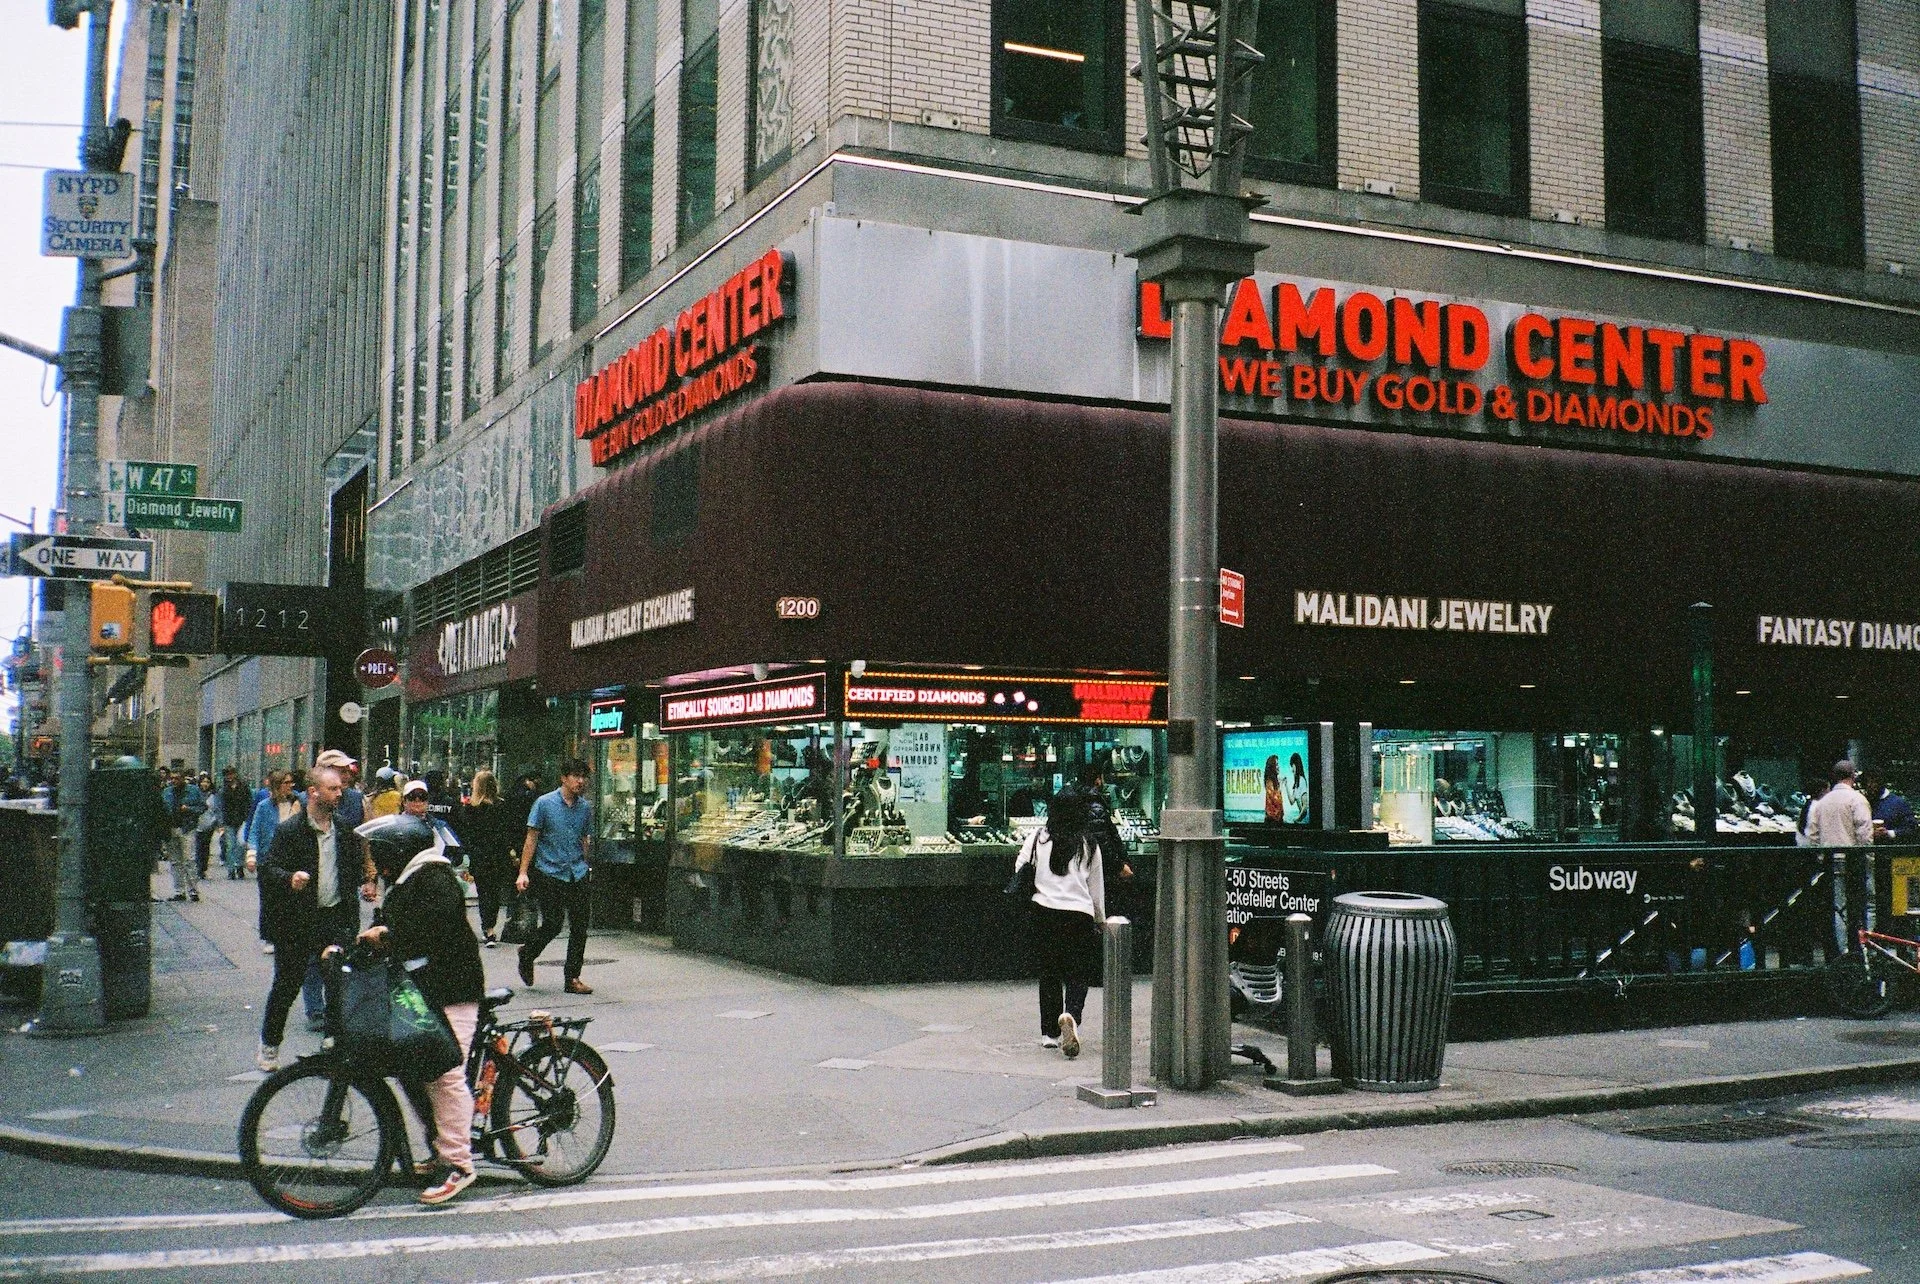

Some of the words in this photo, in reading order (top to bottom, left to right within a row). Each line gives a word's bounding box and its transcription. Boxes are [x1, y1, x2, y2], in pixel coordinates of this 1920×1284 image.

[57, 177, 118, 195] NYPD
[49, 234, 123, 251] CAMERA
[576, 327, 671, 439] DIAMOND
[675, 248, 784, 377] CENTER
[1141, 278, 1490, 371] AMOND
[1514, 313, 1769, 404] CENTER
[1219, 355, 1282, 397] WE
[1293, 364, 1369, 405] BUY
[1376, 372, 1483, 415] GOLD
[1492, 385, 1517, 419] &
[1527, 389, 1715, 439] DIAMONDS
[128, 466, 144, 490] W
[150, 467, 174, 491] 47
[127, 498, 181, 517] Diamond
[187, 501, 236, 523] Jewelry
[37, 547, 76, 566] ONE
[96, 551, 137, 569] WAY
[643, 588, 695, 631] EXCHANGE
[778, 600, 817, 616] 1200
[1297, 592, 1428, 629] MALIDANI
[1431, 600, 1553, 634] JEWELRY
[1759, 616, 1856, 648] FANTASY
[367, 663, 388, 674] PRET
[667, 699, 706, 721] ETHICALLY
[706, 694, 746, 716] SOURCED
[745, 691, 764, 713] LAB
[764, 685, 815, 710] DIAMONDS
[848, 688, 915, 702] CERTIFIED
[918, 690, 986, 705] DIAMONDS
[895, 755, 938, 765] DIAMONDS
[914, 744, 941, 752] GROWN
[1226, 769, 1262, 794] BEACHES
[1249, 870, 1290, 890] Streets
[1549, 866, 1638, 894] Subway
[1226, 888, 1277, 908] ckefeller
[1280, 891, 1320, 912] Center
[1226, 906, 1254, 924] ation
